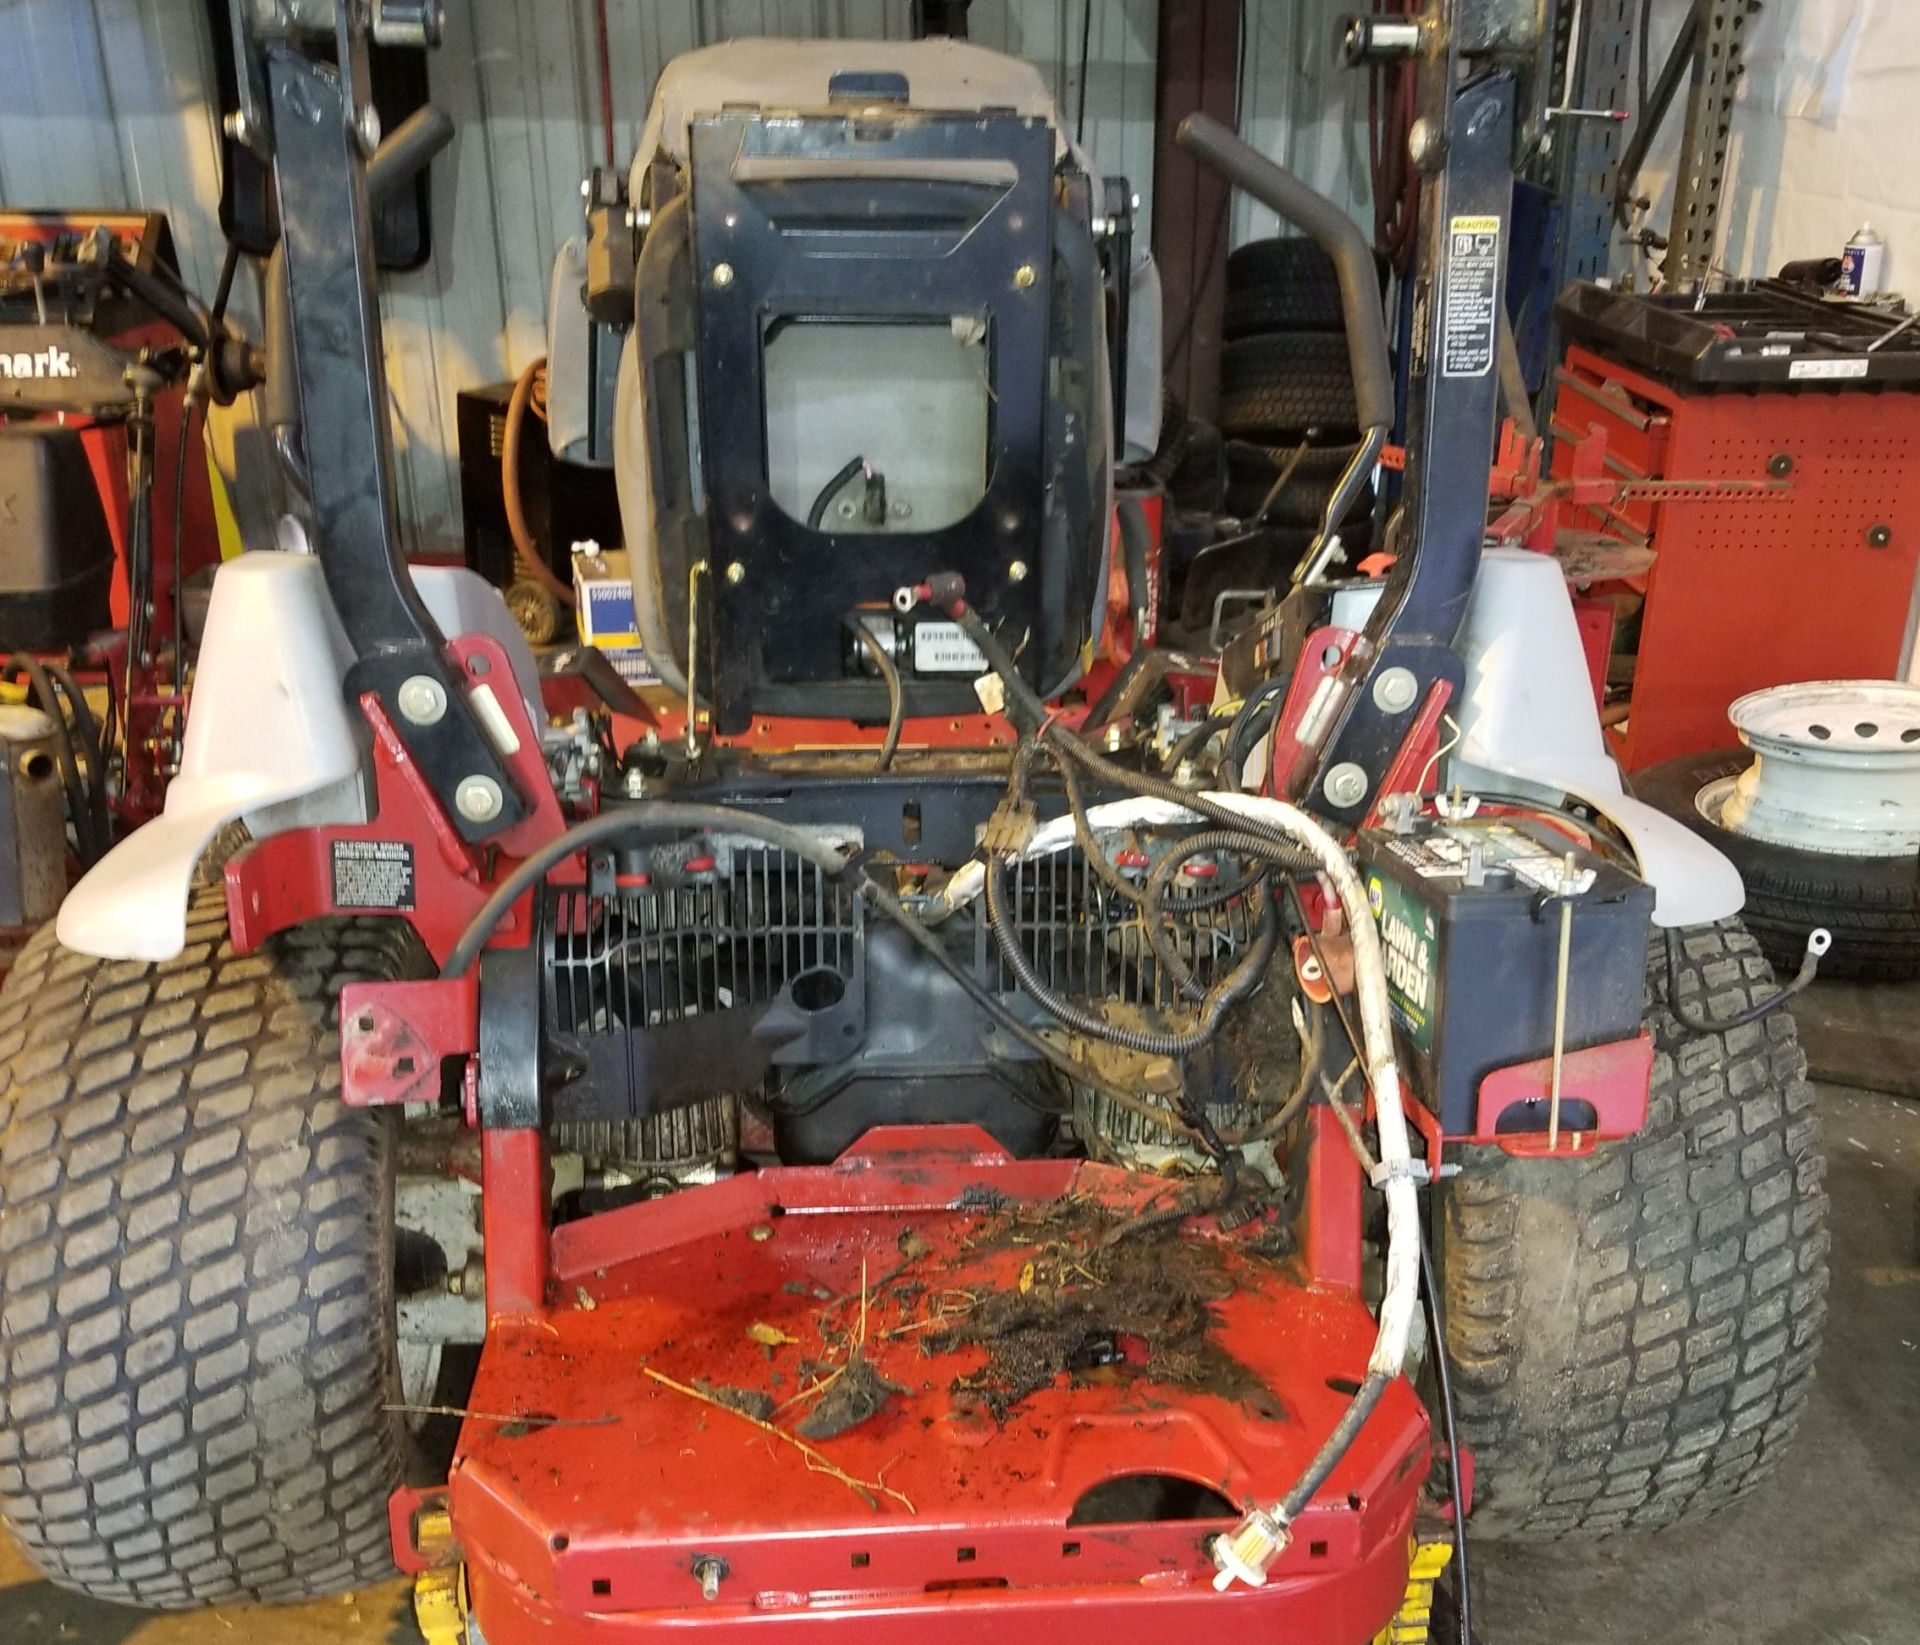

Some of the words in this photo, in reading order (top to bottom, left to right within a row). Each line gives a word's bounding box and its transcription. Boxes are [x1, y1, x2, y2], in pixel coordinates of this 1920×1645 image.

[1460, 219, 1497, 230] CAUTION
[375, 850, 410, 861] WARNING
[1381, 908, 1417, 963] LAWN
[1417, 939, 1429, 973] &
[1381, 940, 1429, 1011] ARDEN
